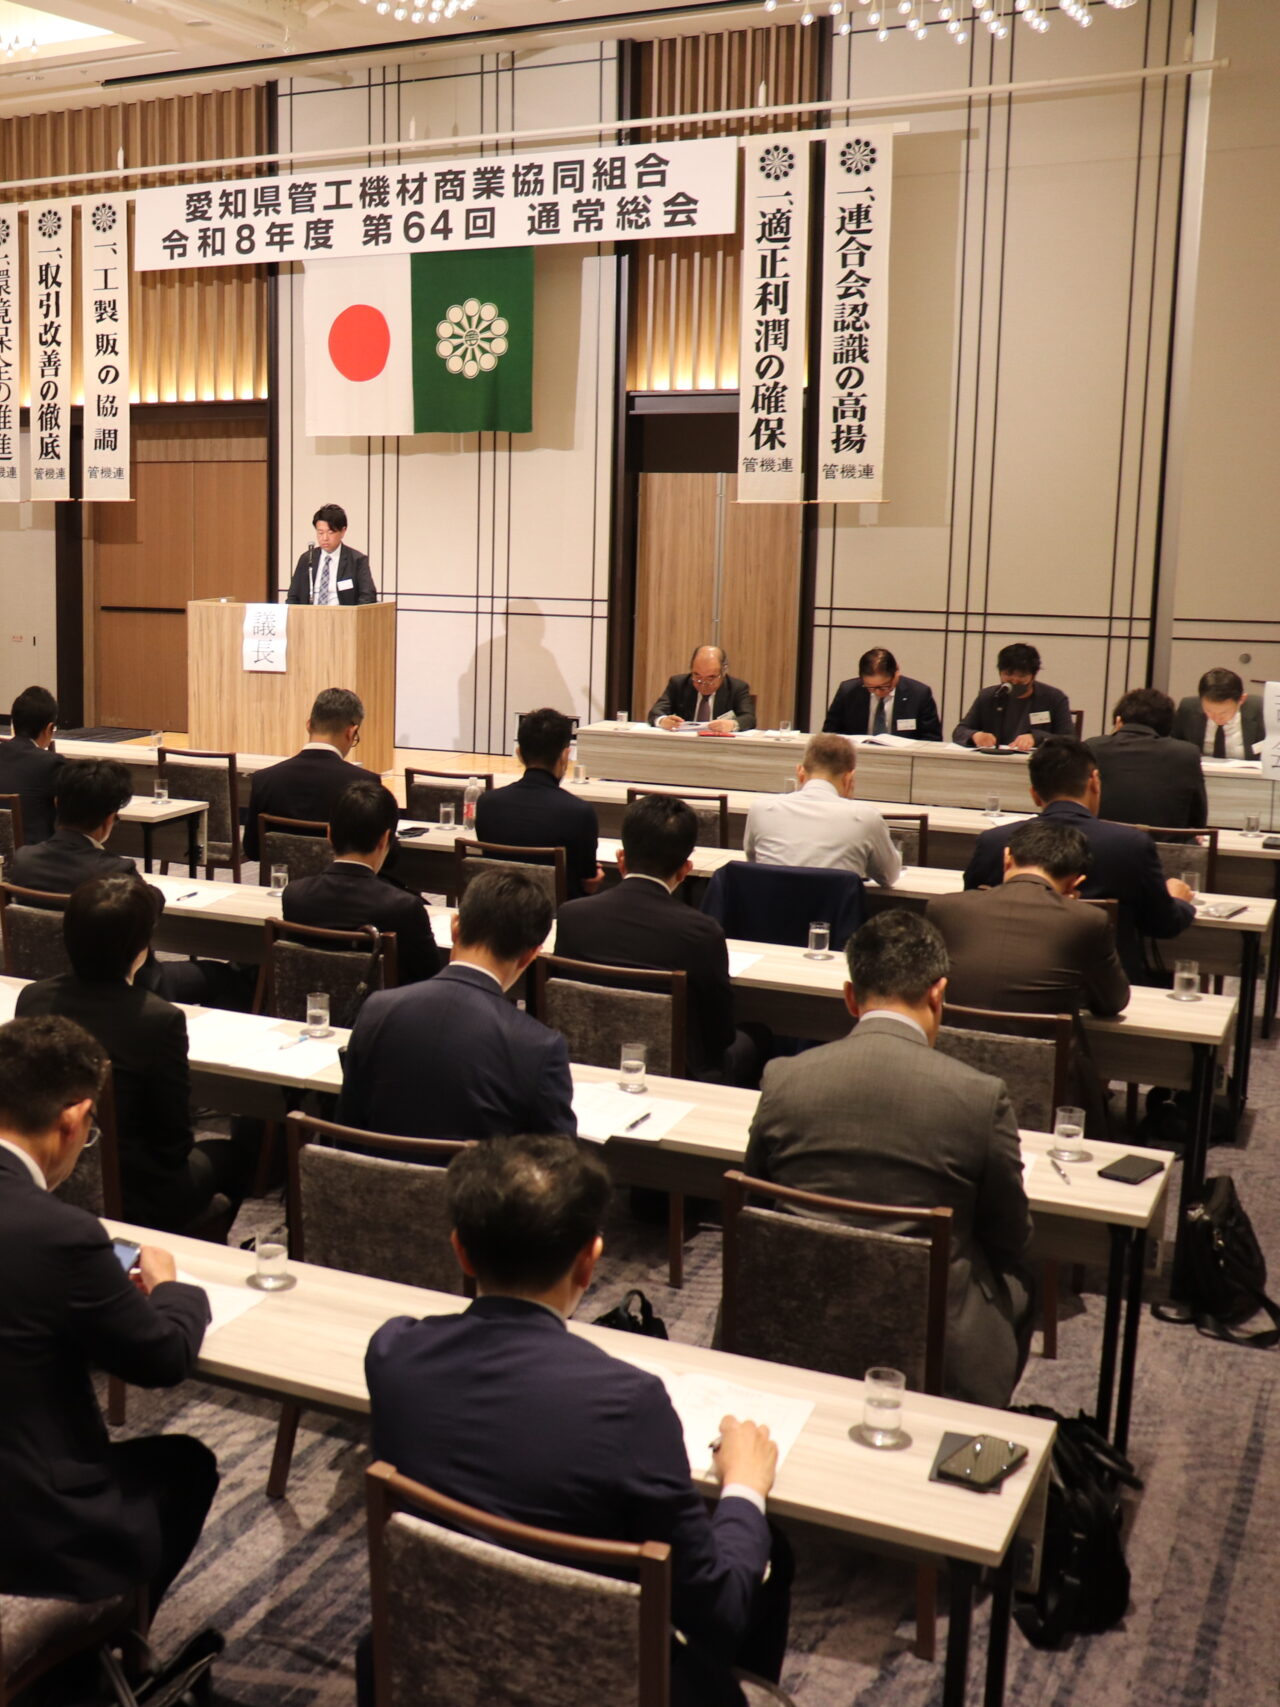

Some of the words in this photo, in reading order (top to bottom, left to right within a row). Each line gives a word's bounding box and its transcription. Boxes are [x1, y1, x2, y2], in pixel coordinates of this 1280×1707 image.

[161, 218, 334, 260] 令和8年度
[362, 206, 496, 246] 第64回
[527, 191, 699, 236] 通常総会
[185, 152, 670, 223] 愛知県管工機材商業協同組合
[37, 247, 63, 460] 一、取引改善の徹底
[93, 240, 120, 452] 一、工製販の協調
[749, 191, 794, 451] 一、適正利潤の確保
[831, 186, 876, 454] 一、連合会認識の高揚
[253, 611, 277, 664] 議長
